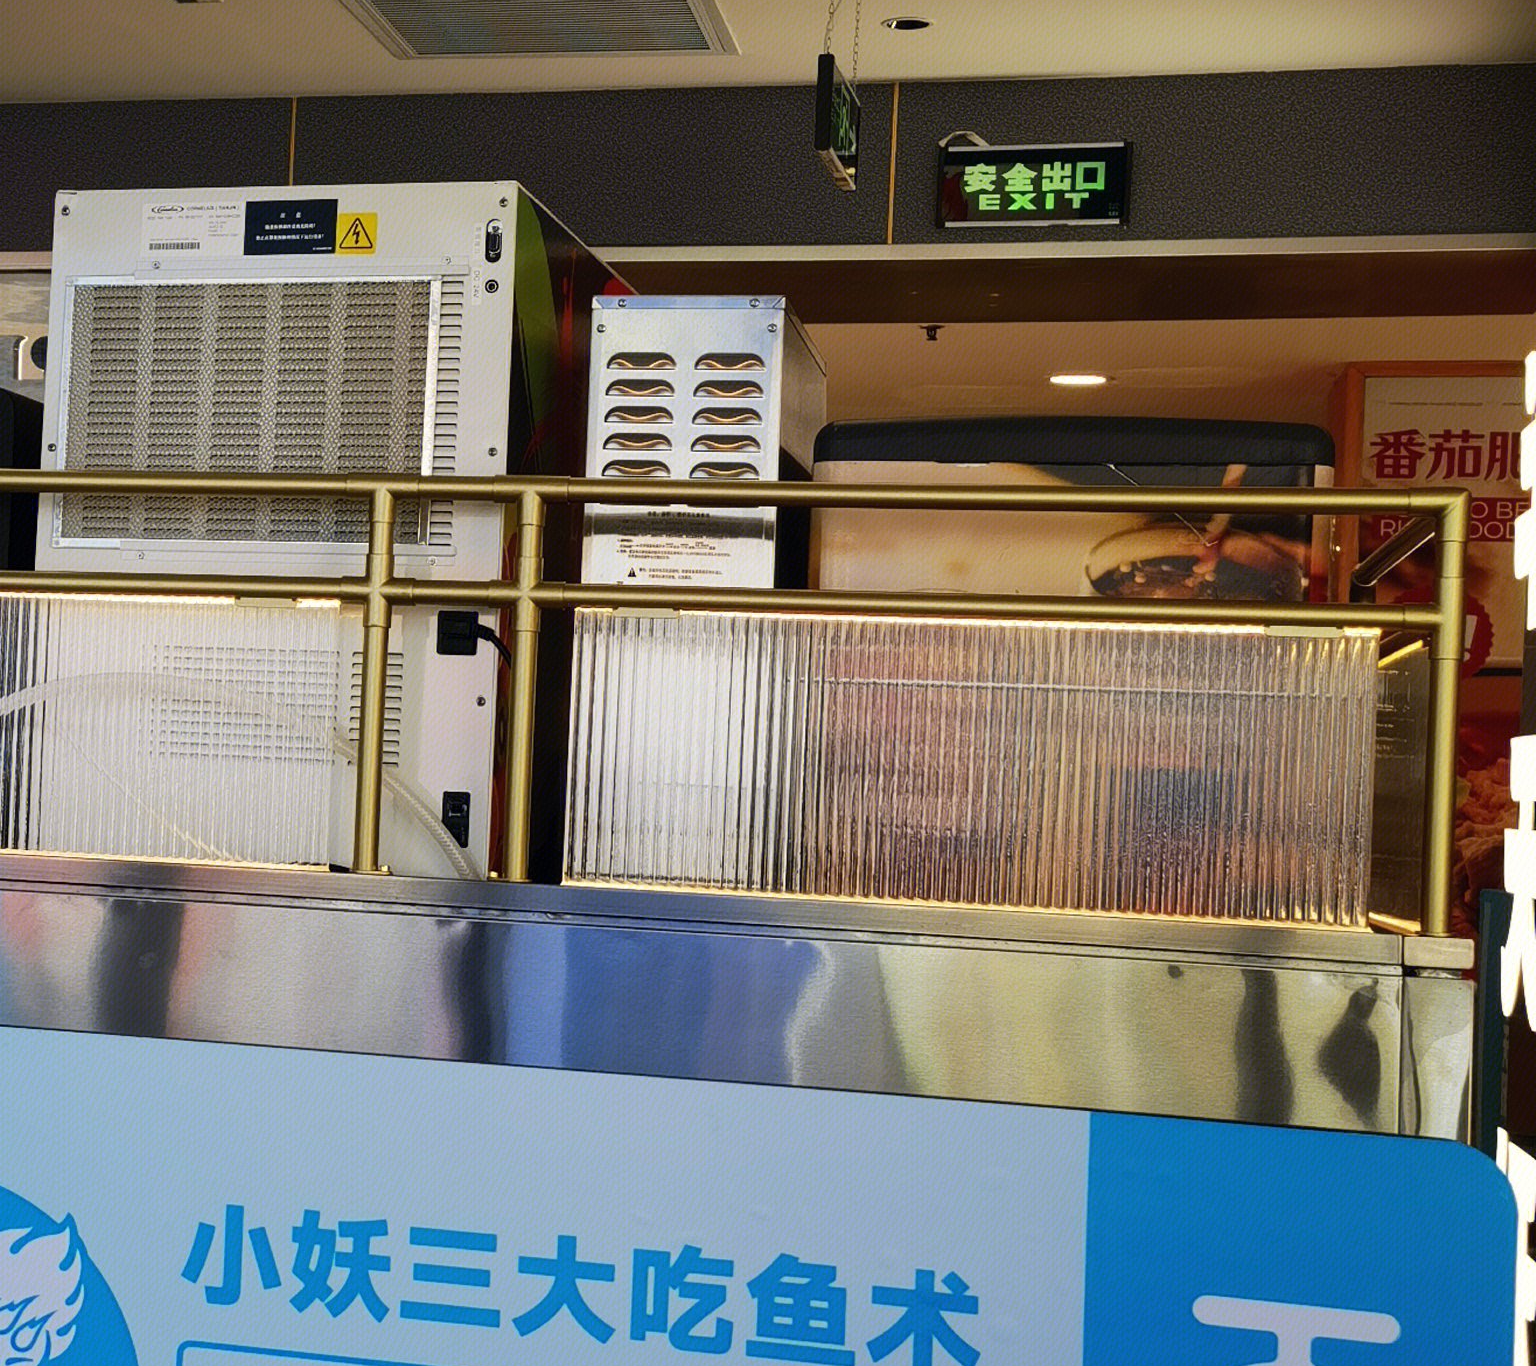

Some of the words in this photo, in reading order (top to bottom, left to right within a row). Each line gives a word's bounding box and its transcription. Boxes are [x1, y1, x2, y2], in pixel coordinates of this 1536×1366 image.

[964, 161, 1106, 193] 安全出口
[978, 192, 1090, 211] EXIT
